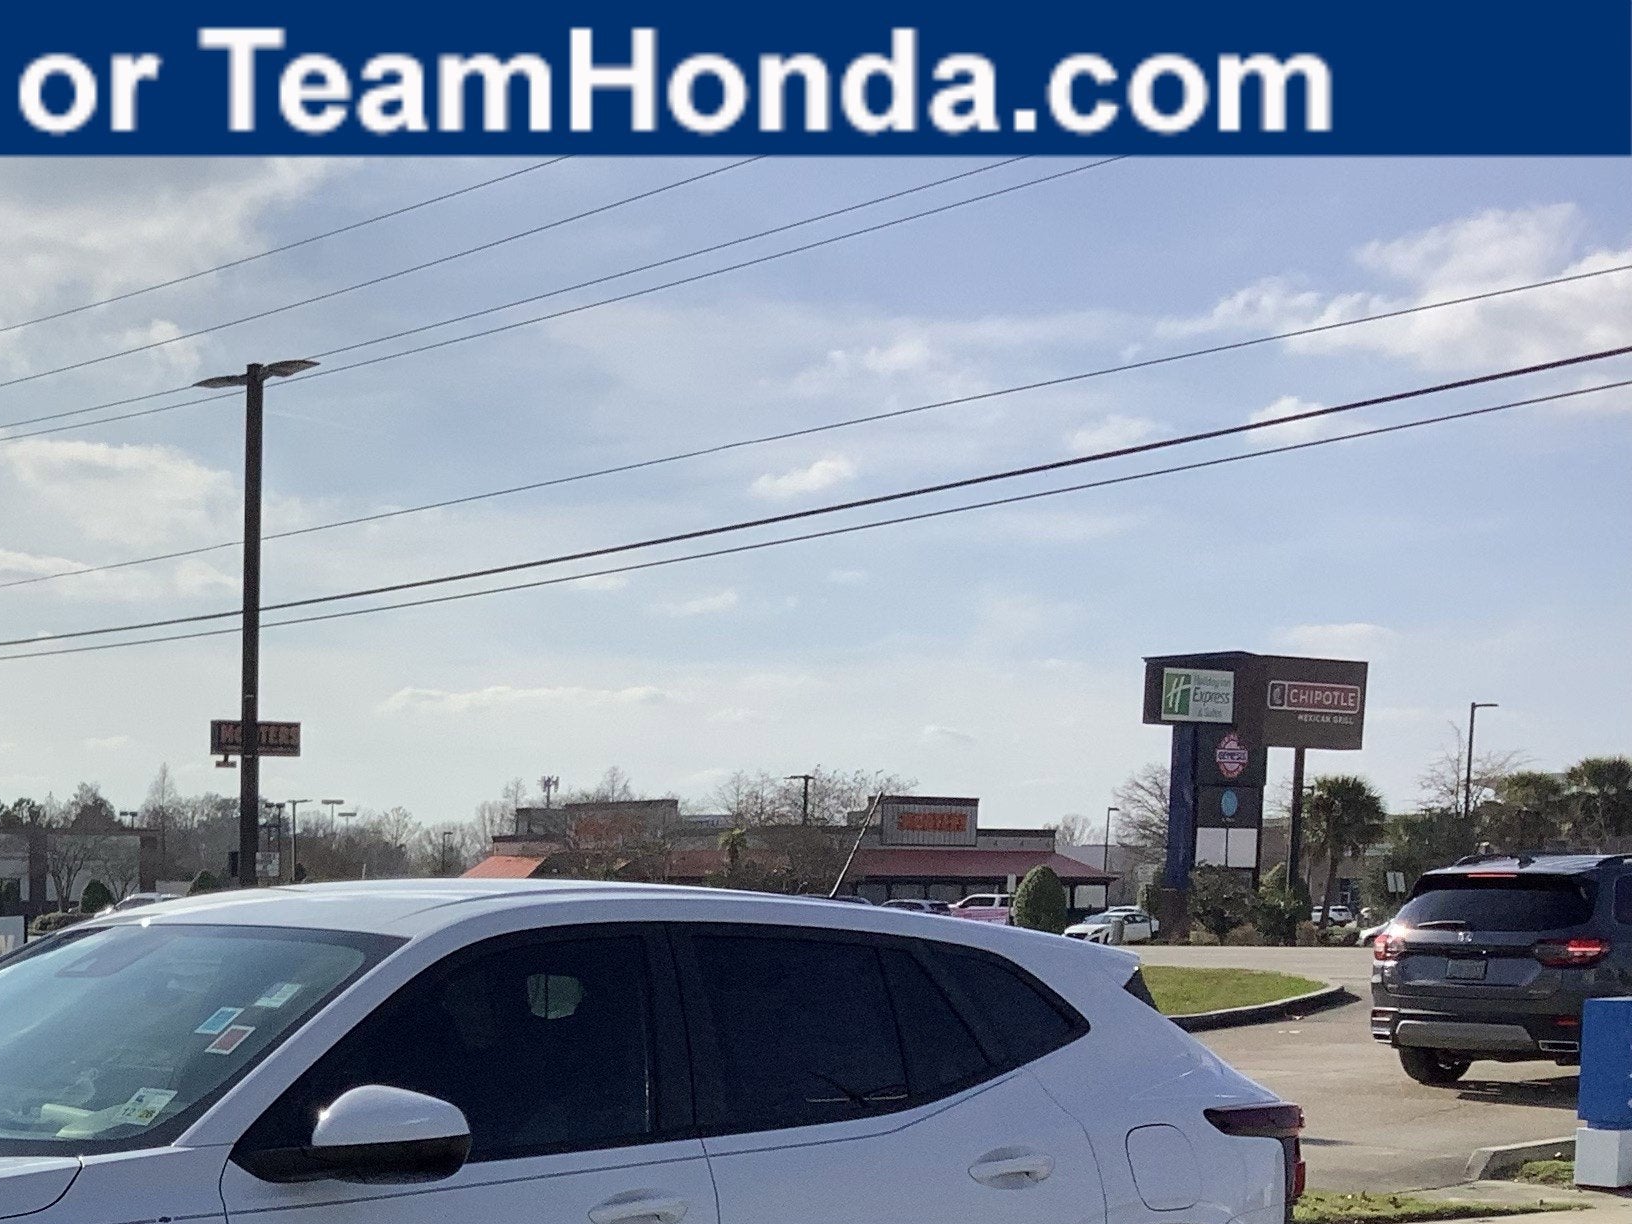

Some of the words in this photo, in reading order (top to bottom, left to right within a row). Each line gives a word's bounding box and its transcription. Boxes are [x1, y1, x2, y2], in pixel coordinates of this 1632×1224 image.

[1192, 686, 1231, 706] Express
[1289, 688, 1356, 707] CHIPOTLE
[1297, 713, 1331, 723] MEXICAN
[219, 723, 299, 745] HOTERS
